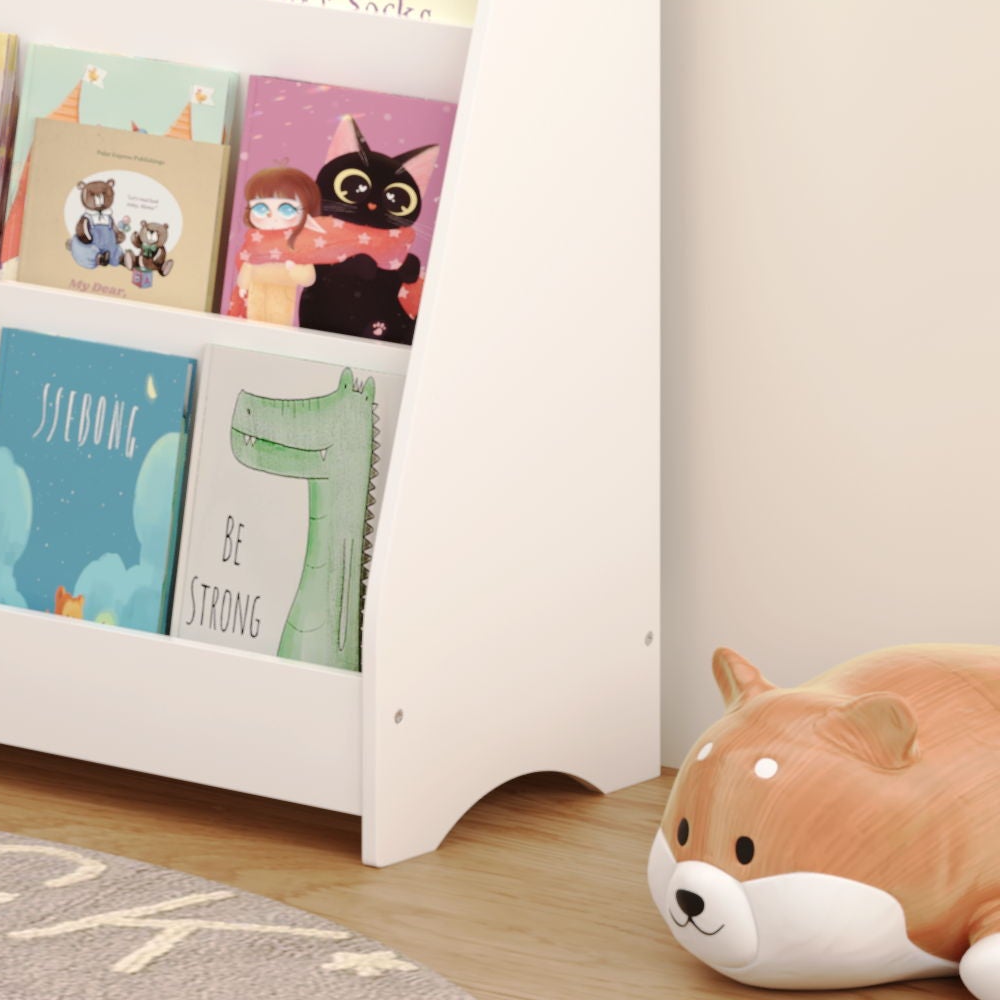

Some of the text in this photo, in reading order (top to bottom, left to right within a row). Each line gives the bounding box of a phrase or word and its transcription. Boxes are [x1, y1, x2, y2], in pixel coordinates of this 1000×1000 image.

[68, 278, 91, 294] My
[32, 382, 140, 459] SSEBONG
[221, 515, 246, 567] BE
[185, 575, 262, 639] STRONG
